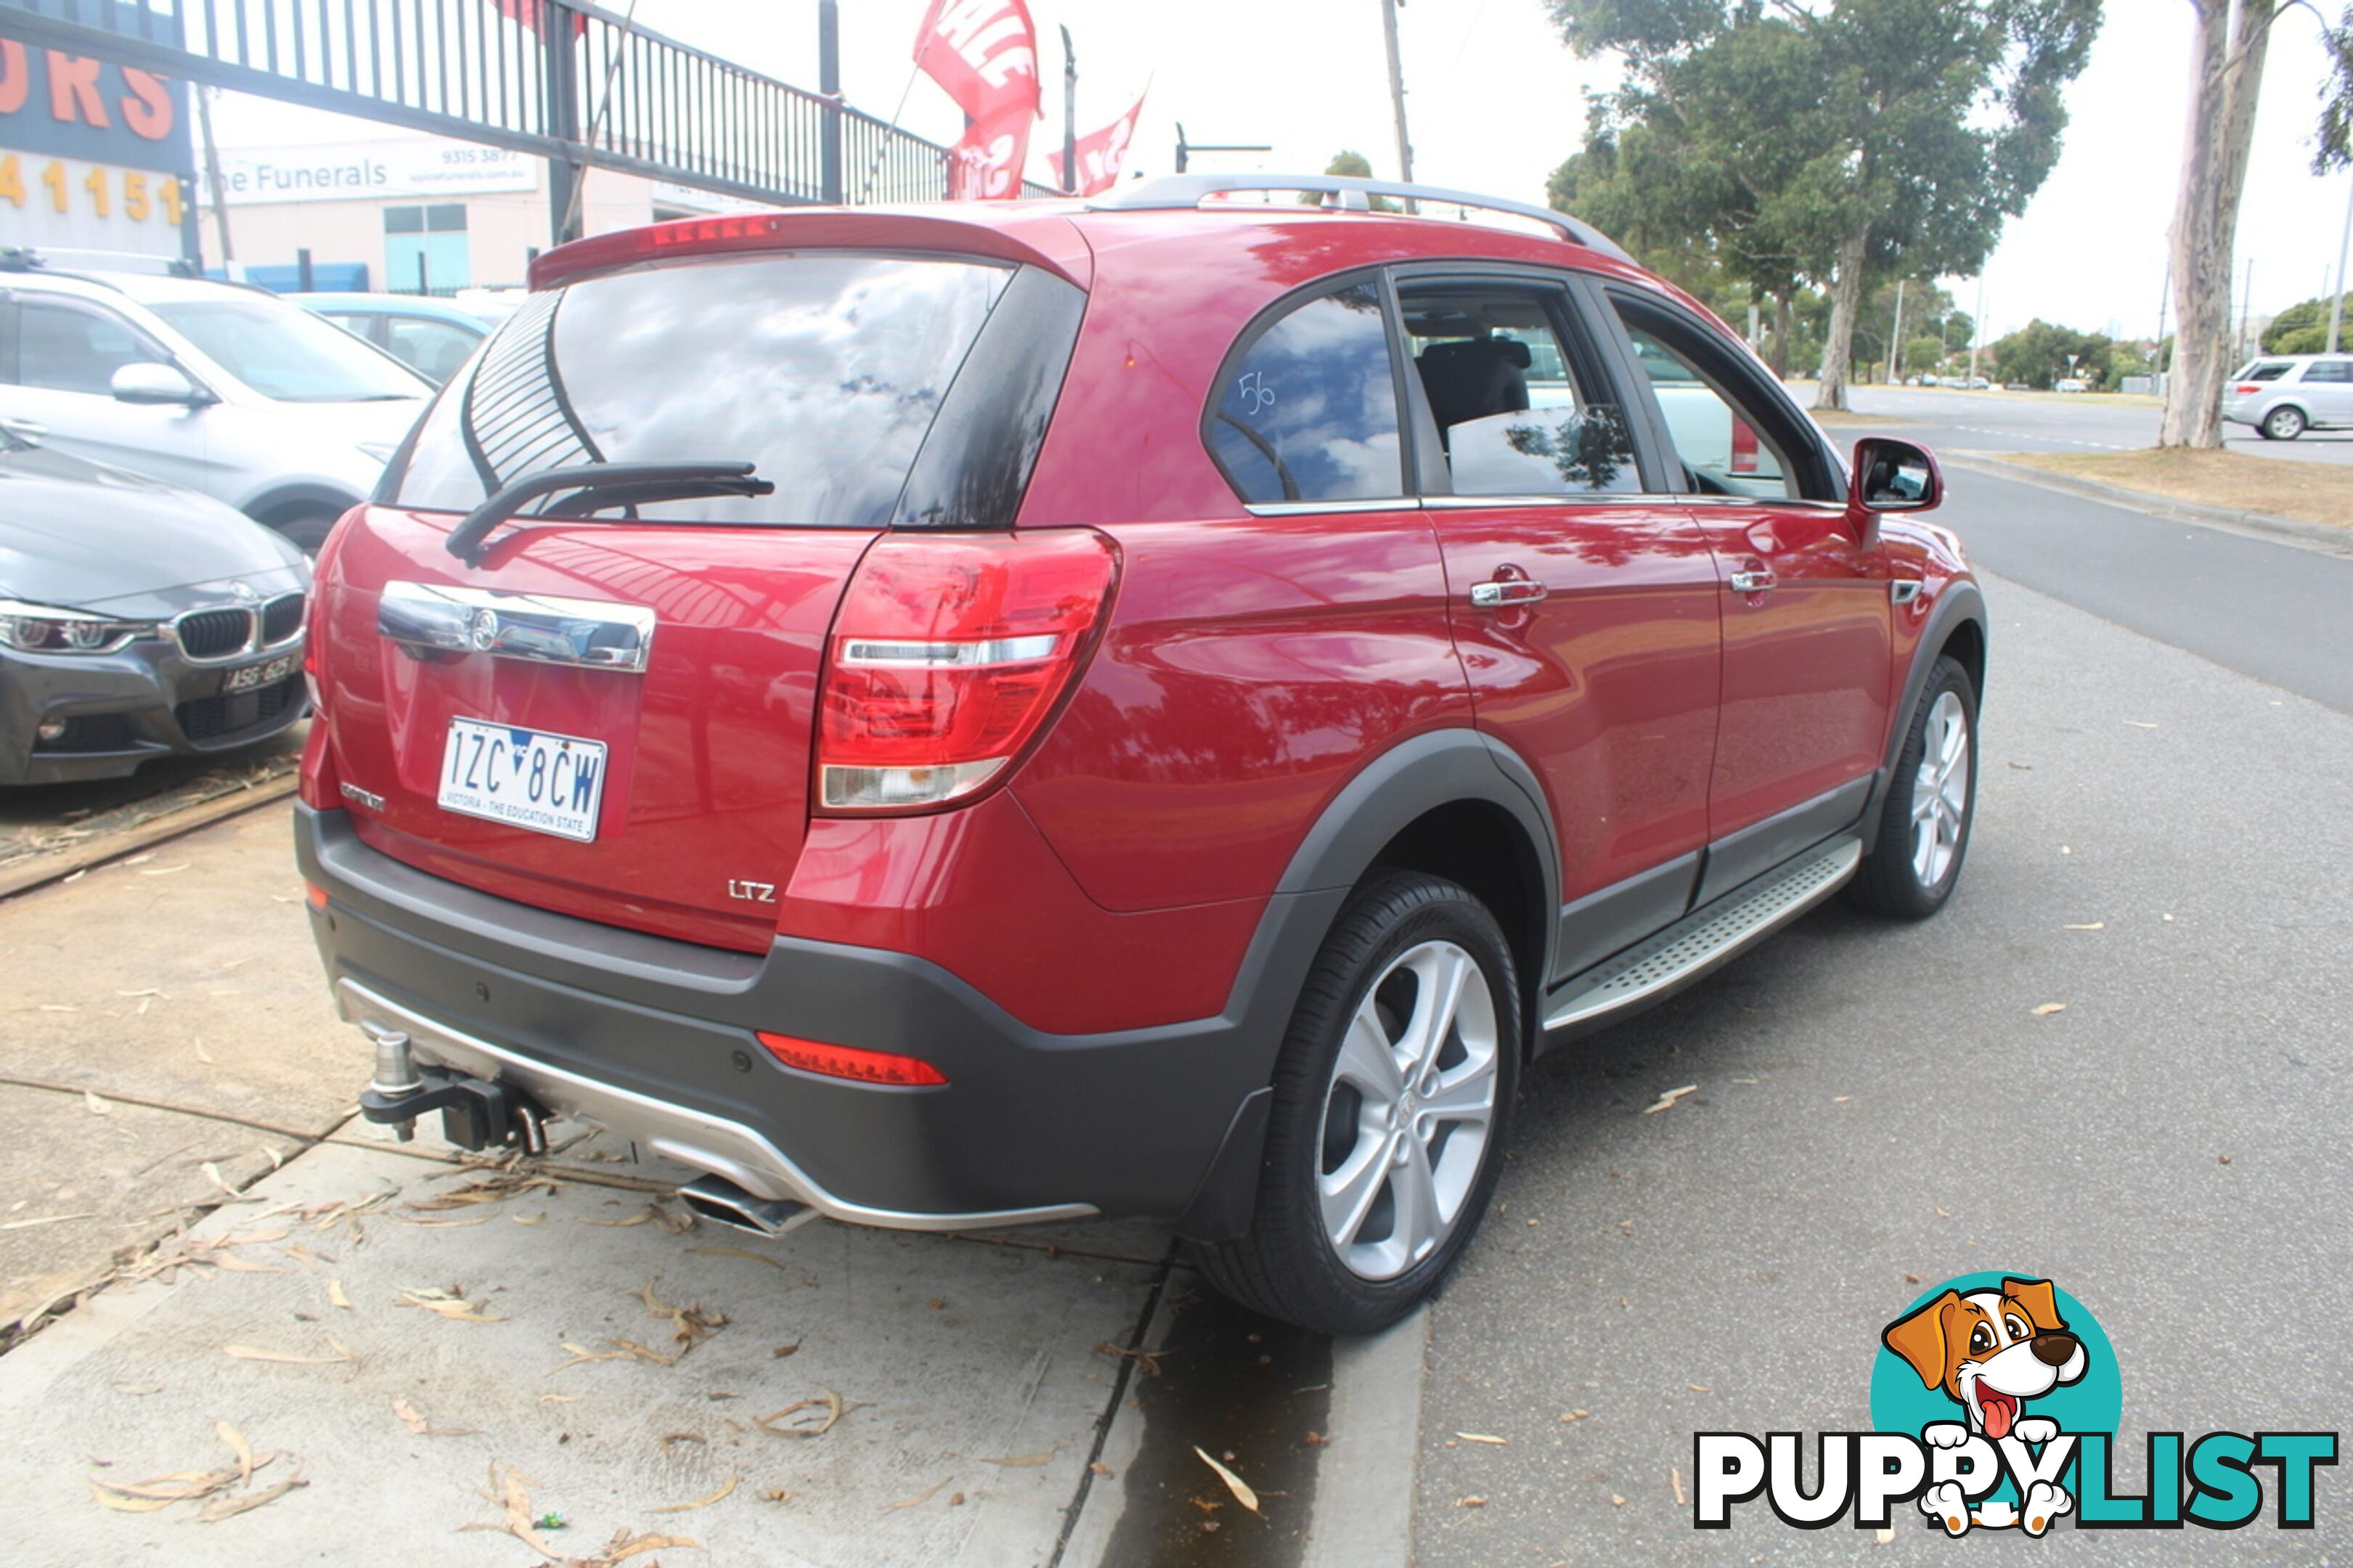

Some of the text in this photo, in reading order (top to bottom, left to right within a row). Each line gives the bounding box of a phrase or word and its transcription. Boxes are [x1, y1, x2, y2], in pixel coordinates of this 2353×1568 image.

[442, 150, 476, 164] 9315
[257, 158, 388, 191] Funerals
[1239, 371, 1276, 415] 56
[447, 792, 481, 810] VICTORIA
[489, 801, 506, 816] THE
[507, 807, 555, 825] EDUCATION
[557, 815, 584, 833] STATE
[728, 879, 776, 903] LTZ
